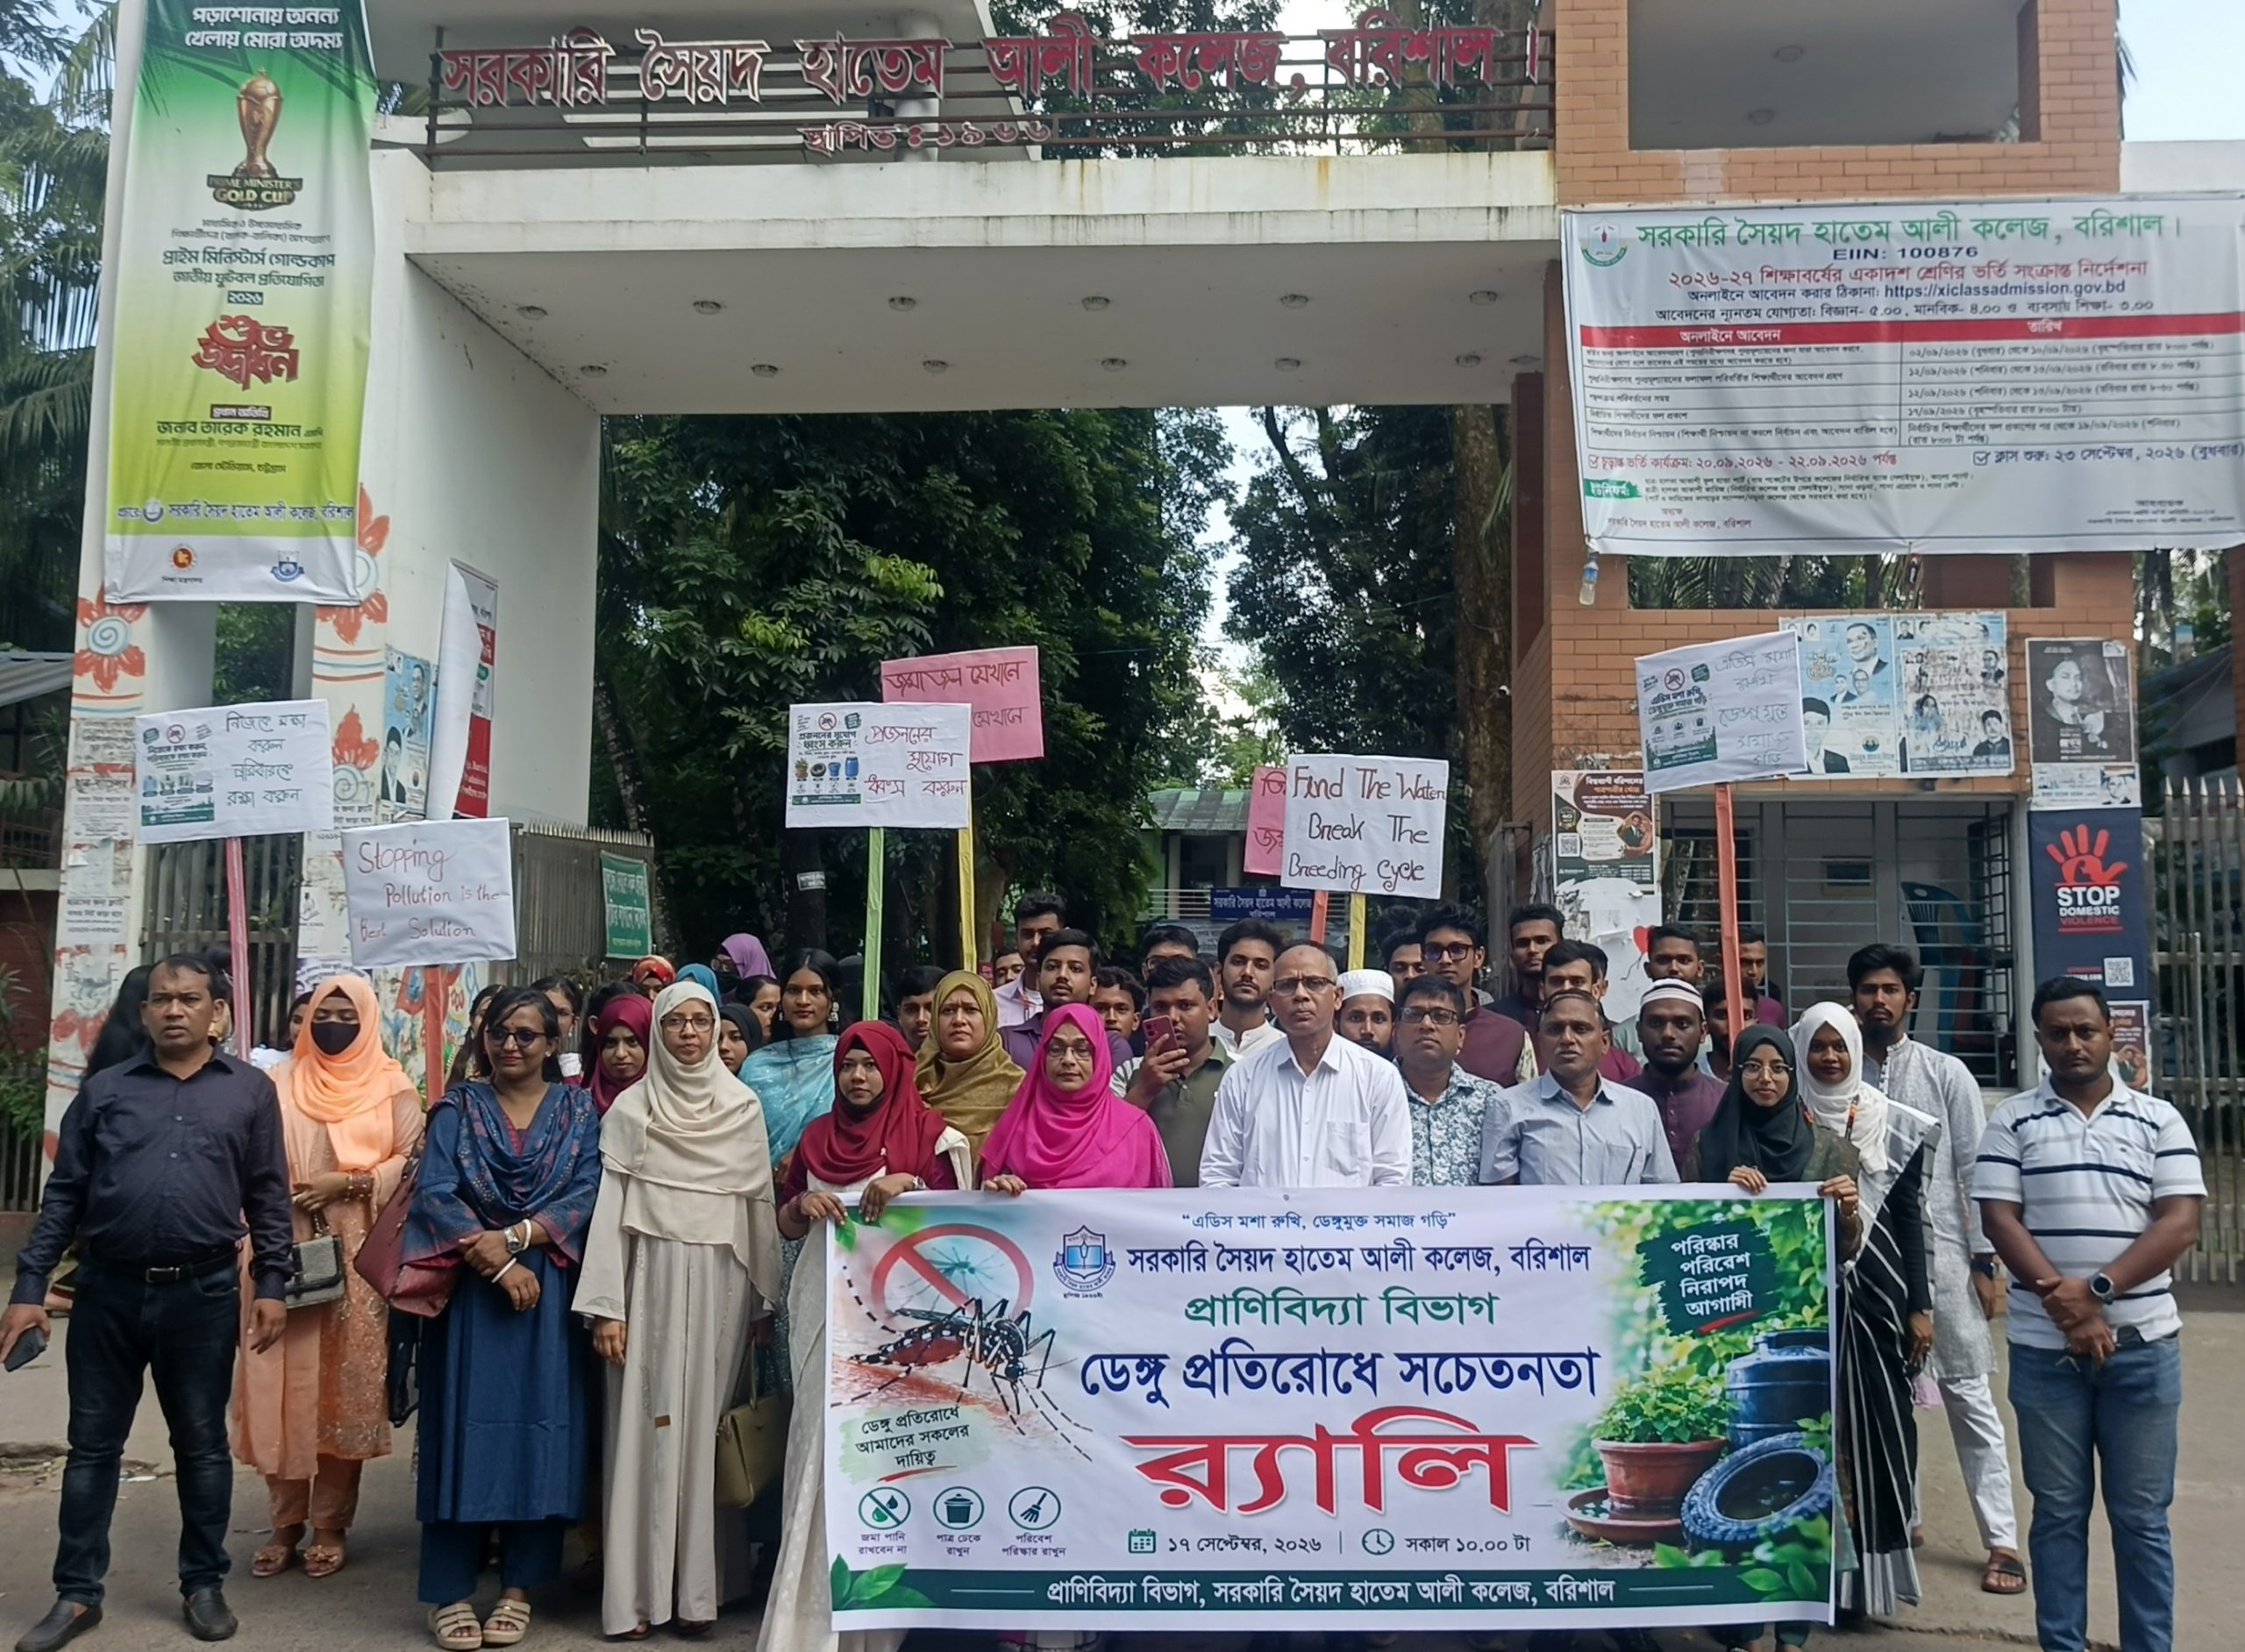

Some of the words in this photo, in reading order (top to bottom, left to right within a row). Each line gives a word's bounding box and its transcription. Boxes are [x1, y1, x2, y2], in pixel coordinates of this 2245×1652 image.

[192, 7, 282, 25] পড়াশোনায়
[286, 8, 339, 25] অনন্য
[185, 31, 239, 48] খেলায়
[243, 32, 286, 49] মোরা
[438, 25, 616, 108] সরকারি
[634, 28, 772, 105] সৈয়দ
[794, 32, 955, 106] হাতেম
[979, 12, 1104, 99] আলী
[1316, 7, 1505, 94] বরিশাল
[219, 188, 257, 203] GOLD
[1636, 217, 1728, 248] সরকারি
[1735, 216, 1803, 246] সৈয়দ
[1812, 219, 1892, 246] হাতেম
[1900, 210, 1962, 242] আলী
[2072, 208, 2163, 241] বরিশাল
[1897, 246, 1978, 259] 100876
[1849, 267, 1910, 282] একাদশ
[1972, 260, 2006, 279] ভর্তি
[1687, 288, 1744, 303] অনলাইনে
[1750, 288, 1797, 300] আবেদন
[1679, 328, 1733, 343] অনলাইনে
[1736, 328, 1781, 342] আবেদন
[201, 421, 249, 436] তারেক
[253, 423, 302, 438] রহমান
[1356, 766, 1392, 800] The
[1396, 772, 1447, 801] Water
[1309, 812, 1365, 841] Break
[1387, 814, 1430, 844] The
[358, 838, 459, 882] Stopping
[1288, 852, 1367, 891] Breeding
[1377, 858, 1425, 892] Cycle
[384, 882, 453, 908] Pollution
[460, 885, 473, 901] is
[477, 883, 511, 902] the
[2057, 885, 2121, 907] STOP
[2059, 905, 2120, 917] DOMESTIC
[2061, 916, 2120, 926] VIOLENCE
[408, 917, 476, 940] Solution
[1238, 1214, 1266, 1229] মশা
[1374, 1214, 1415, 1229] সমাজ
[1127, 1240, 1209, 1275] সরকারি
[1215, 1240, 1274, 1274] সৈয়দ
[1284, 1243, 1353, 1276] হাতেম
[1361, 1237, 1417, 1273] আলী
[1422, 1245, 1502, 1277] কলেজ,
[1508, 1237, 1592, 1273] বরিশাল
[1679, 1273, 1750, 1299] নিরাপদ
[1185, 1286, 1369, 1327] প্রাণিবিদ্যা
[1379, 1285, 1500, 1326] বিভাগ
[1080, 1353, 1171, 1408] ডেঙ্গু
[1183, 1336, 1384, 1399] প্রতিরোধে
[1394, 1346, 1602, 1399] সচেতনতা
[861, 1415, 891, 1436] ডেঙ্গু
[895, 1406, 960, 1429] প্রতিরোধে
[856, 1434, 915, 1456] আমাদের
[919, 1423, 970, 1445] সকলের
[895, 1449, 937, 1469] দায়িত্ব
[861, 1533, 880, 1542] জমা
[884, 1531, 905, 1542] পানি
[1016, 1532, 1053, 1544] পরিবেশ
[1168, 1537, 1190, 1553] ১৭
[1197, 1535, 1267, 1556] সেপ্টেম্বর,
[1274, 1538, 1322, 1554] ২০২৬
[1405, 1535, 1449, 1553] সকাল
[1456, 1537, 1508, 1554] ১০.০০
[1513, 1532, 1531, 1553] টা
[859, 1545, 894, 1556] রাখবেন
[896, 1545, 908, 1555] না
[946, 1546, 970, 1557] রাখুন
[1042, 1547, 1067, 1558] রাখুন
[1046, 1574, 1136, 1605] প্রাণিবিদ্যা
[1142, 1575, 1206, 1607] বিভাগ,
[1212, 1574, 1284, 1604] সরকারি
[1290, 1577, 1343, 1604] সৈয়দ
[1348, 1581, 1411, 1606] হাতেম
[1416, 1573, 1465, 1604] আলী
[1470, 1579, 1537, 1607] কলেজ,
[1544, 1573, 1615, 1603] বরিশাল
